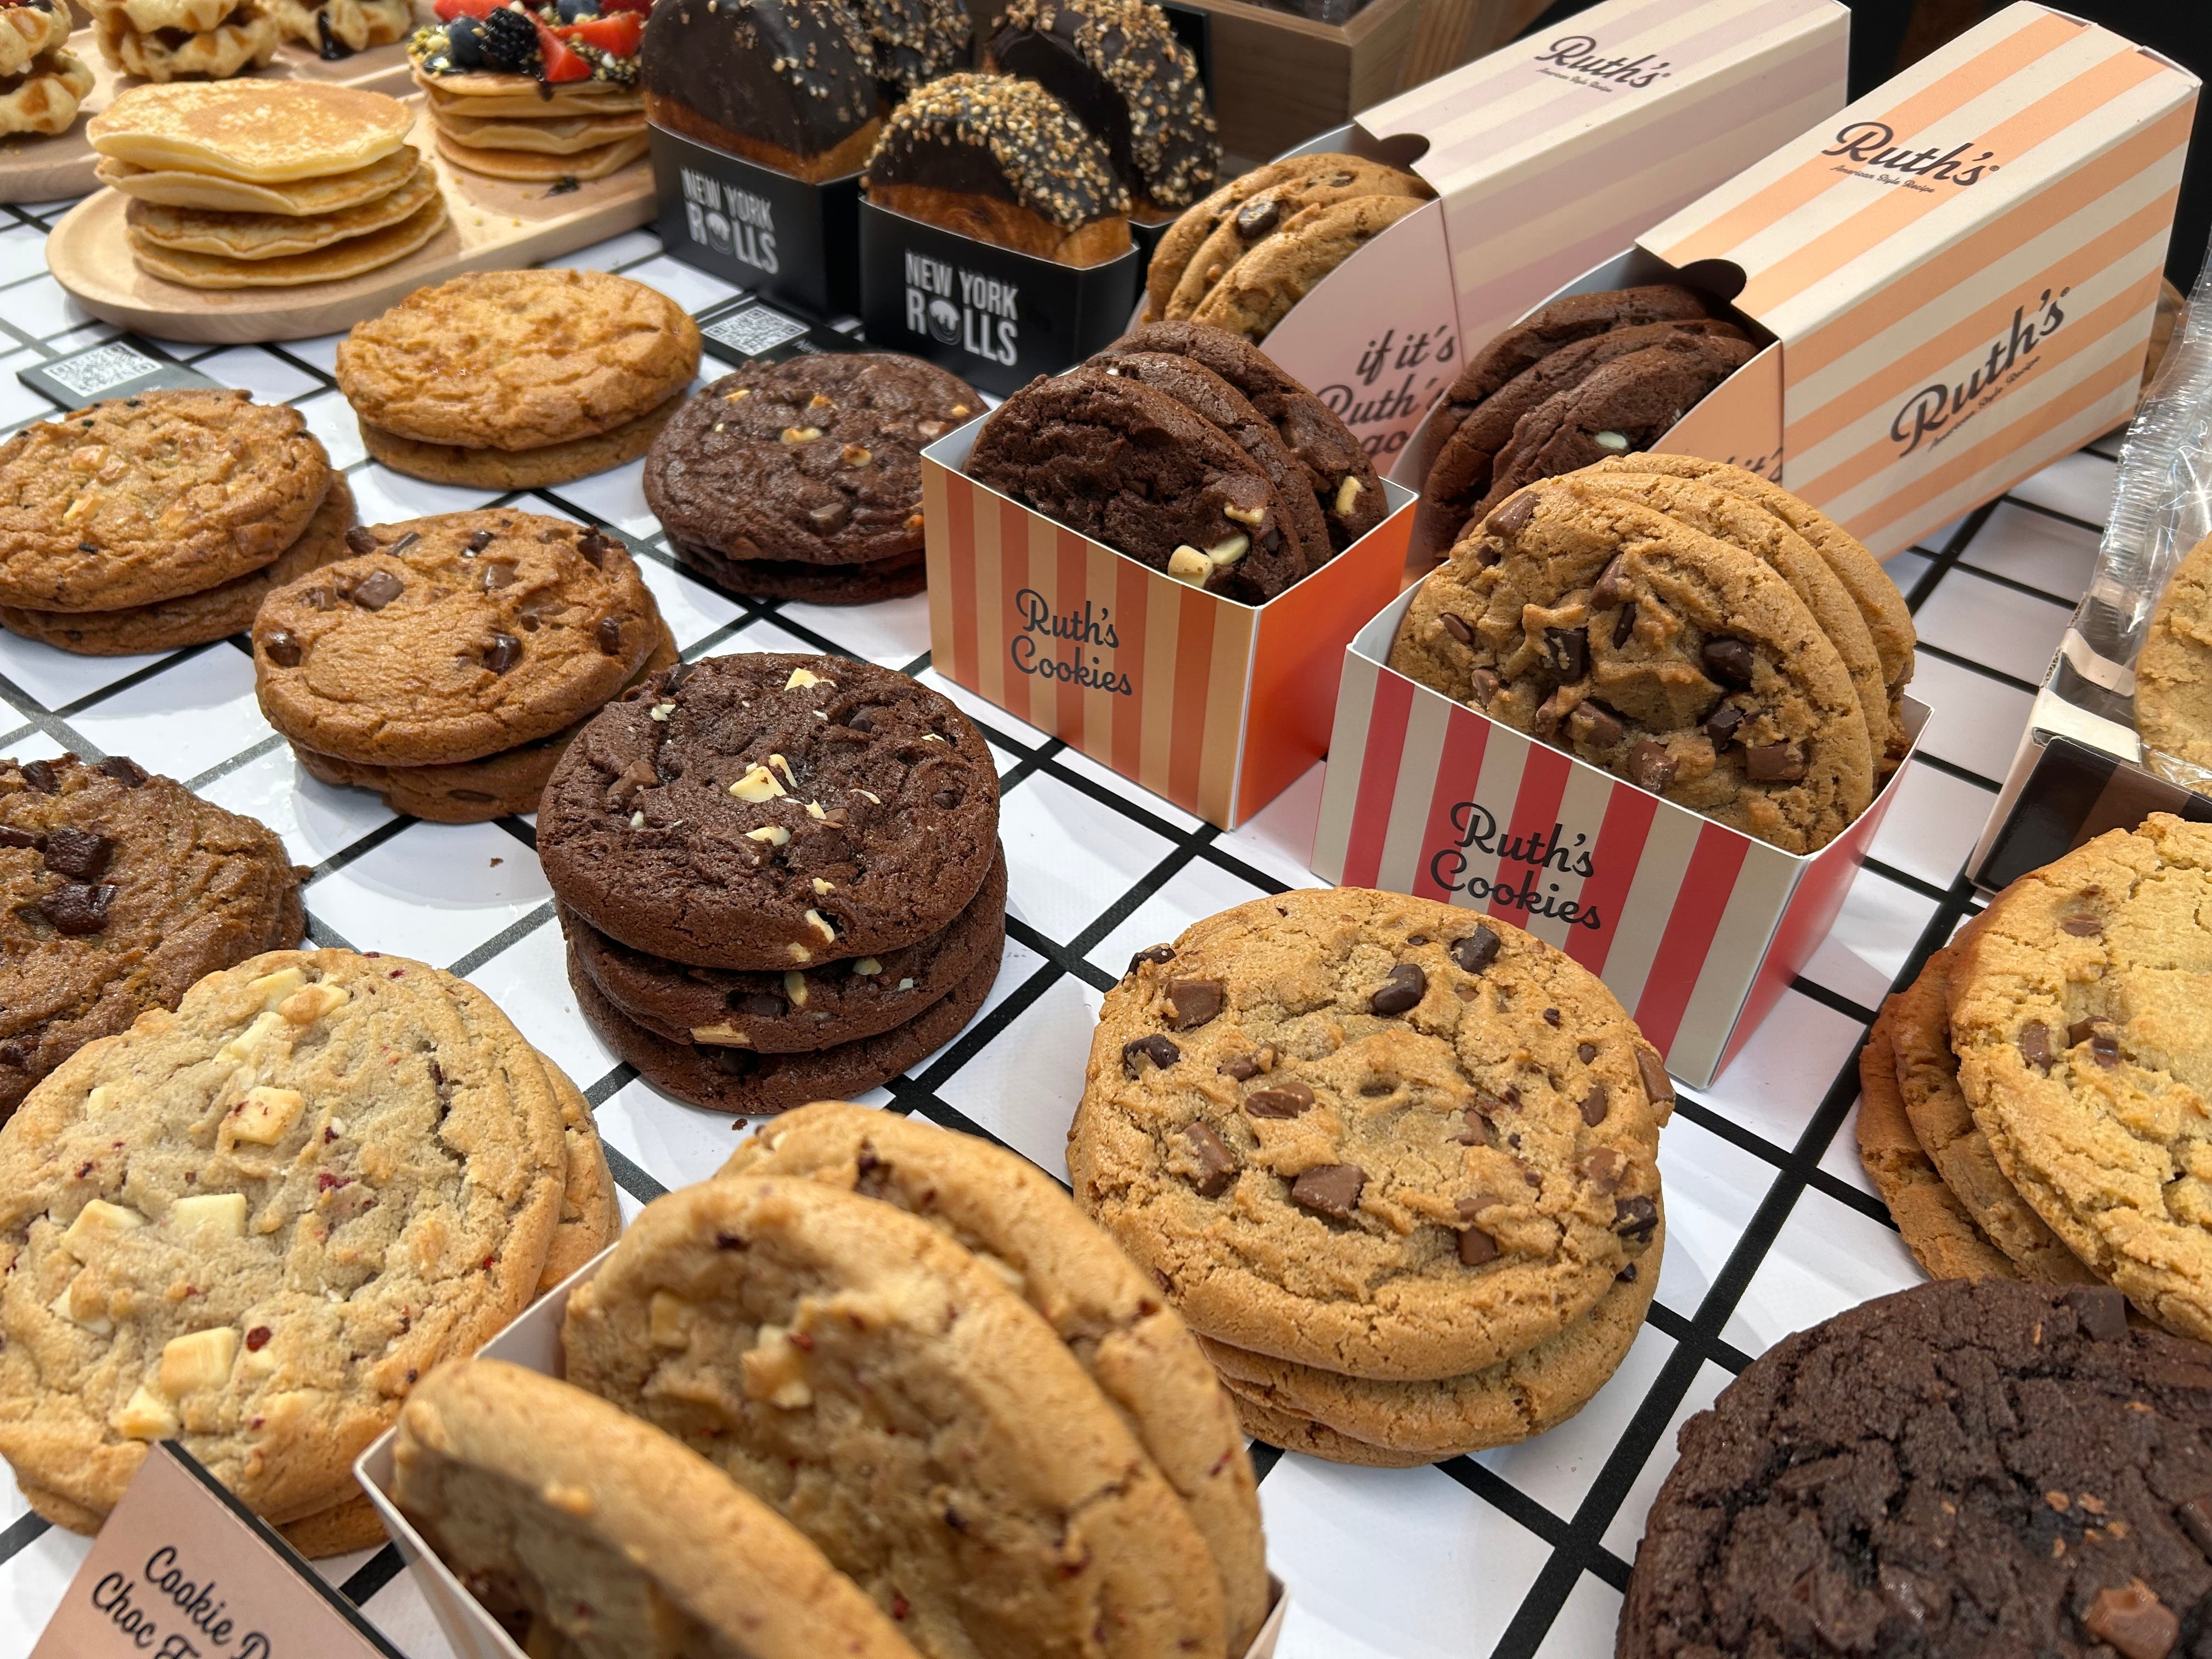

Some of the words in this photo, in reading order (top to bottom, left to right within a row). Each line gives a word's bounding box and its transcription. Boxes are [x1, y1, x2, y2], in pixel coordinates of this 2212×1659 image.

[1534, 36, 1671, 88] Ruth's
[1821, 121, 1995, 187] Ruth's
[1830, 165, 1875, 179] American
[1876, 173, 1900, 185] Style
[1902, 179, 1936, 193] Recipe
[680, 167, 721, 211] NEW
[723, 185, 774, 232] YORK
[686, 201, 779, 274] ROLLS
[905, 252, 953, 297] NEW
[958, 270, 1019, 320] YORK
[906, 287, 1018, 366] ROLLS
[1355, 329, 1395, 386] if
[1393, 325, 1455, 370] it's
[1891, 288, 2065, 458] Ruth's
[1015, 588, 1119, 648] Ruth's
[1011, 635, 1132, 696] Cookies
[1450, 802, 1594, 878] Ruth's
[1430, 849, 1601, 929] Cookies
[92, 1571, 156, 1648] Choc
[145, 1546, 234, 1646] Cookie
